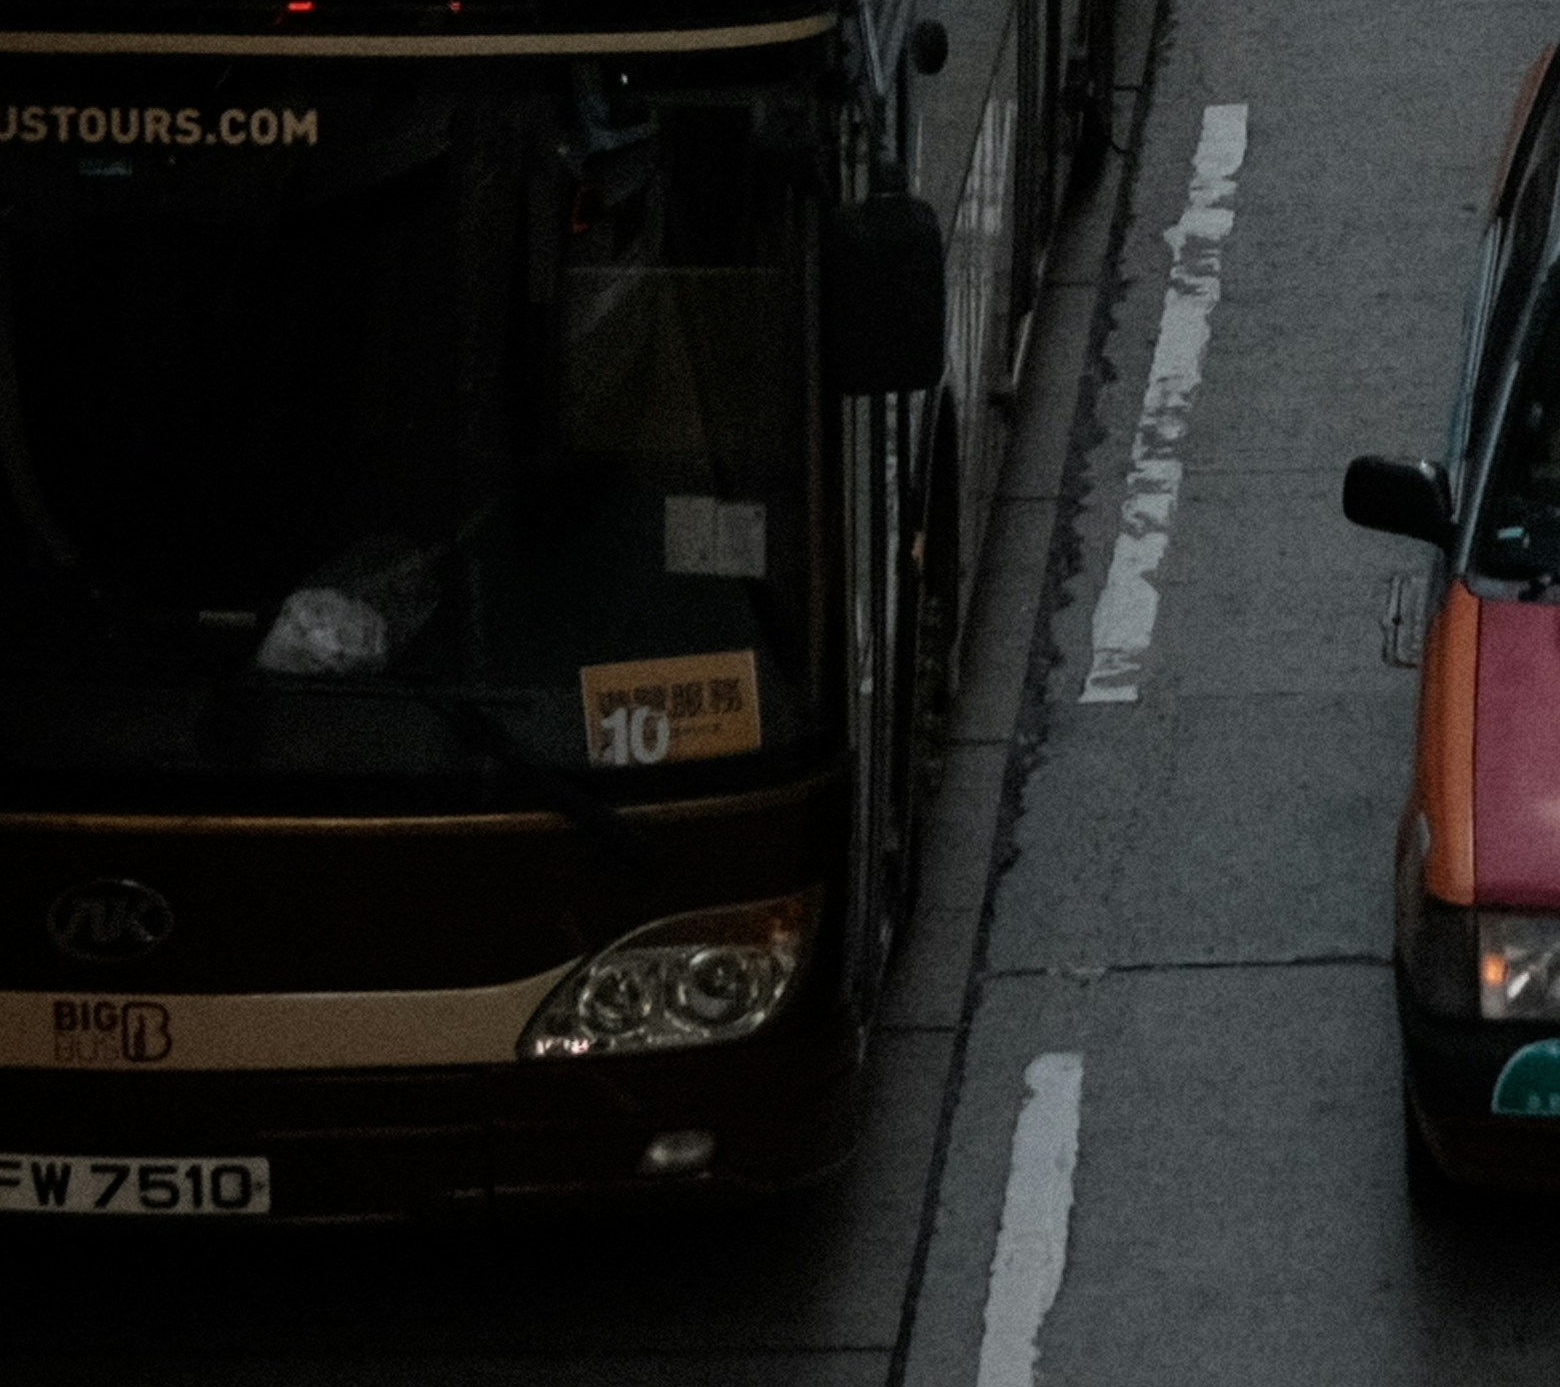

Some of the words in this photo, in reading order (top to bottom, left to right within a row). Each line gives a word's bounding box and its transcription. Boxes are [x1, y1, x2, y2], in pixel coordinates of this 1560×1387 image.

[601, 706, 670, 766] 10
[54, 1001, 118, 1031] BIG
[54, 1033, 120, 1061] BUS
[90, 1164, 252, 1210] 7510
